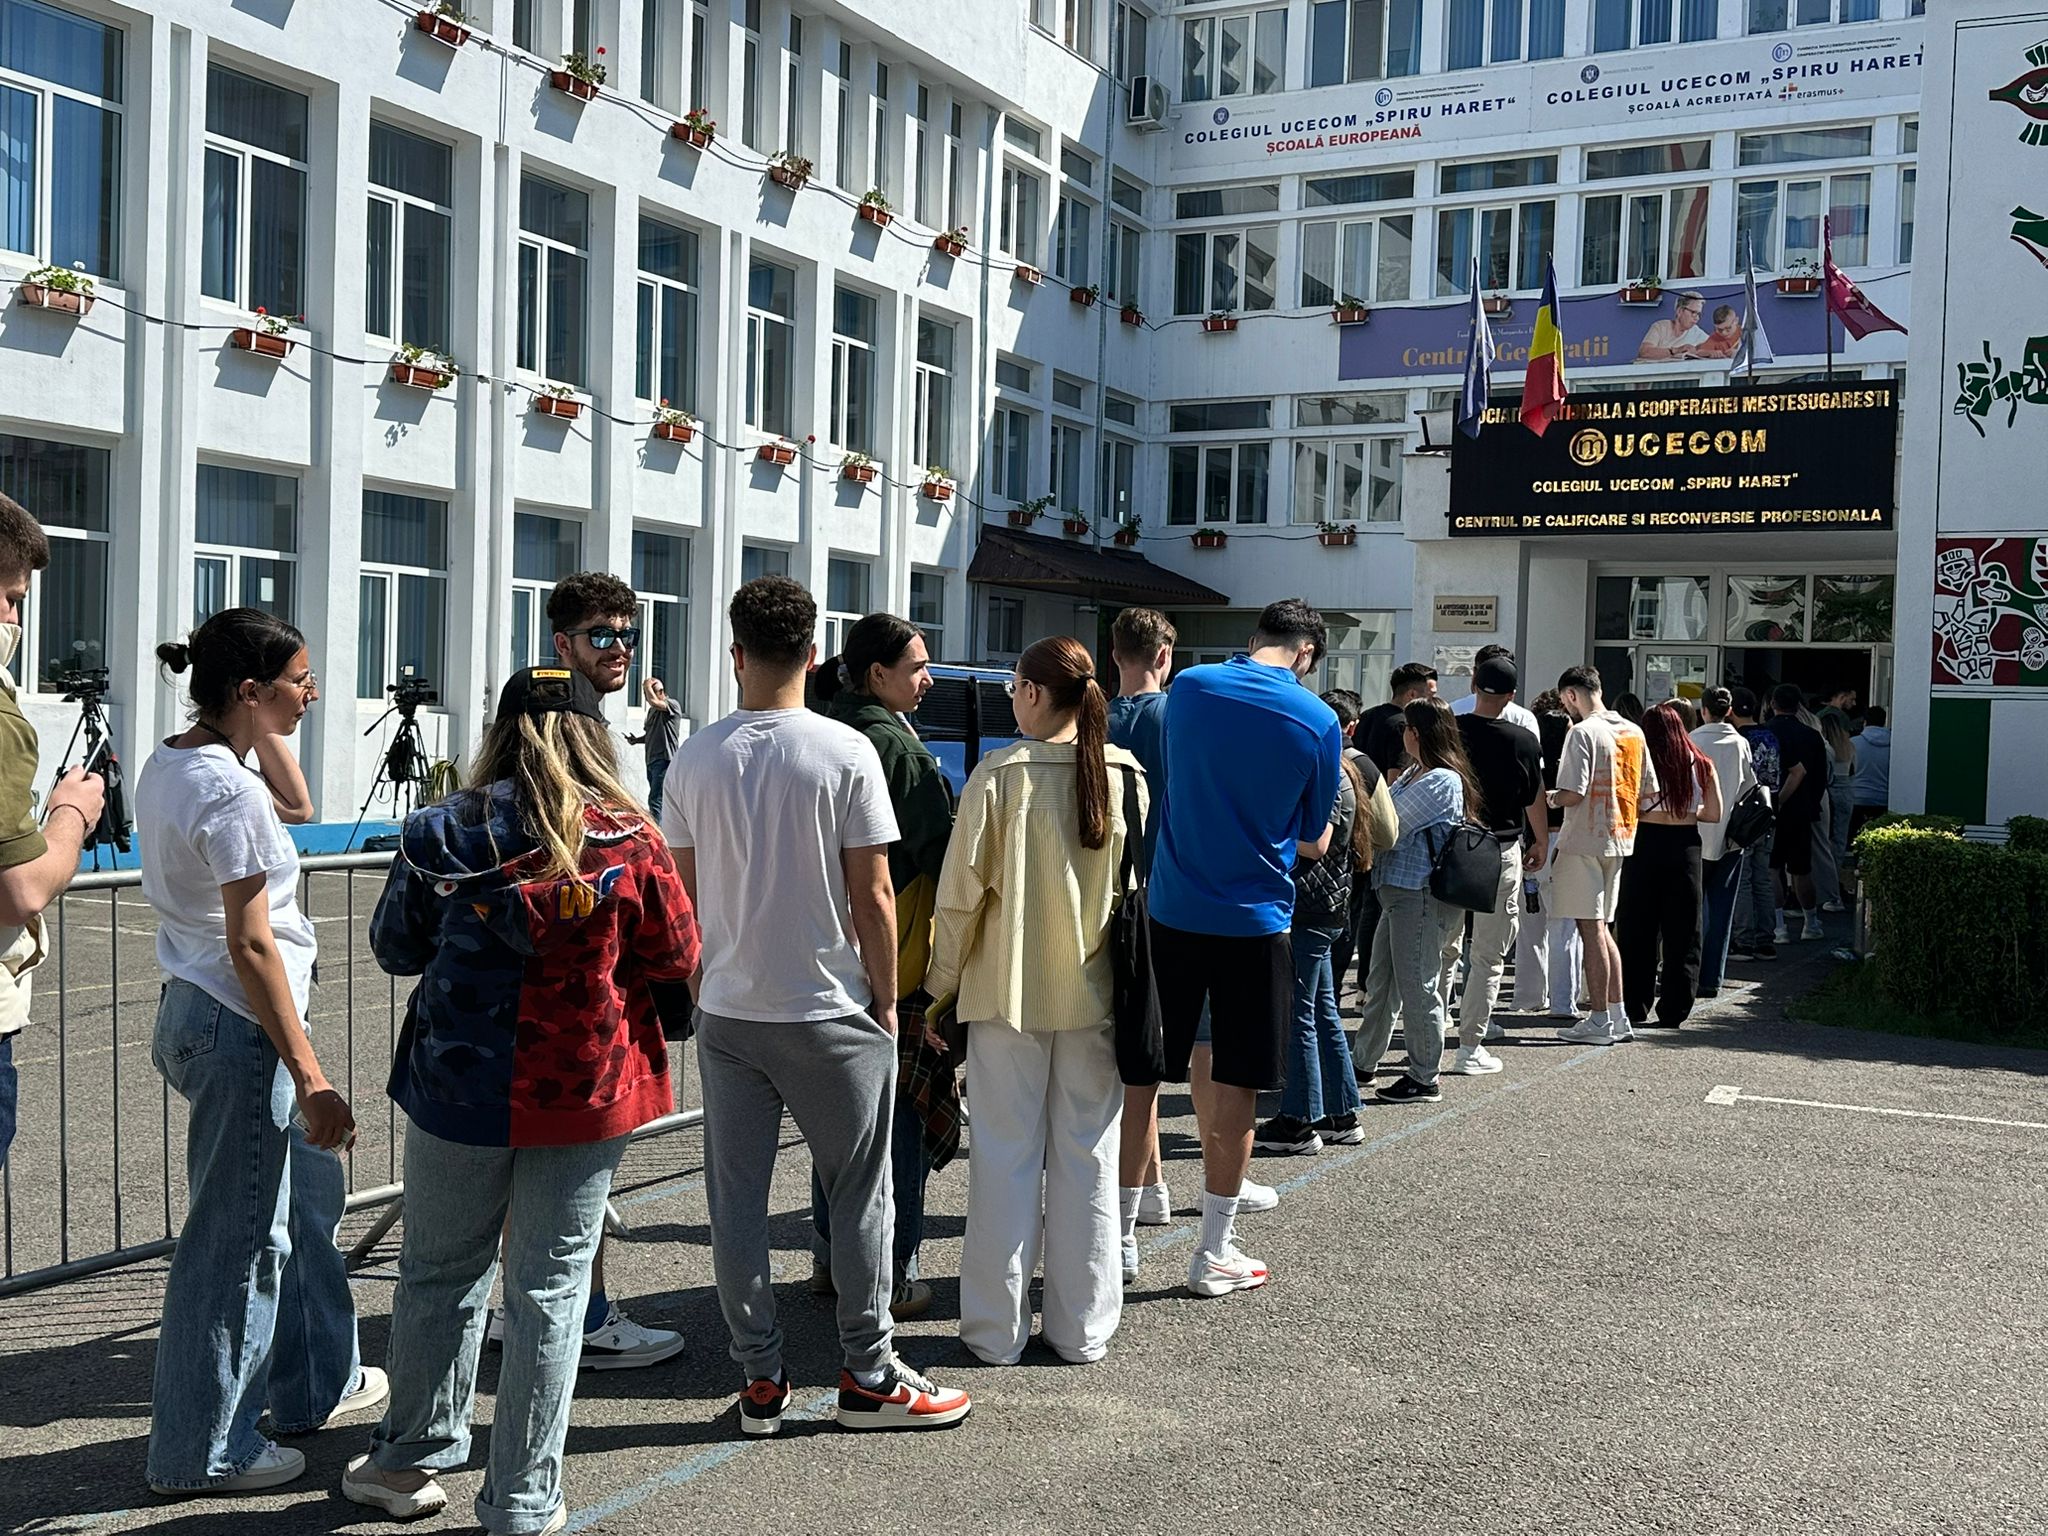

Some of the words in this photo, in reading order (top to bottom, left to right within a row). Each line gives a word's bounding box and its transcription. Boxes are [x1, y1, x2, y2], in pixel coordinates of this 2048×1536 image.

[1547, 82, 1651, 104] COLEGIUL
[1661, 71, 1750, 92] UCECOM
[1761, 62, 1839, 84] „SPIRU
[1797, 89, 1844, 99] erasmus+
[1687, 89, 1772, 106] ACREDITATĂ
[1185, 125, 1272, 144] COLEGIUL
[1281, 115, 1357, 133] UCECOM
[1366, 106, 1431, 127] „SPIRU
[1329, 124, 1421, 146] EUROPEANĂ
[1403, 346, 1468, 368] Centr
[1625, 401, 1636, 418] A
[1639, 396, 1738, 417] COOPERATIEI
[1742, 390, 1890, 413] MESTESUGARESTI
[1614, 429, 1767, 457] UCECOM
[1532, 480, 1602, 493] COLEGIUL
[1610, 478, 1674, 491] UCECOM
[1455, 515, 1518, 528] CENTRUL
[1522, 515, 1541, 527] DE
[1545, 513, 1627, 527] CALIFICARE
[1631, 513, 1645, 525] SI
[1650, 511, 1755, 525] RECONVERSIE
[1761, 508, 1882, 524] PROFESIONALA
